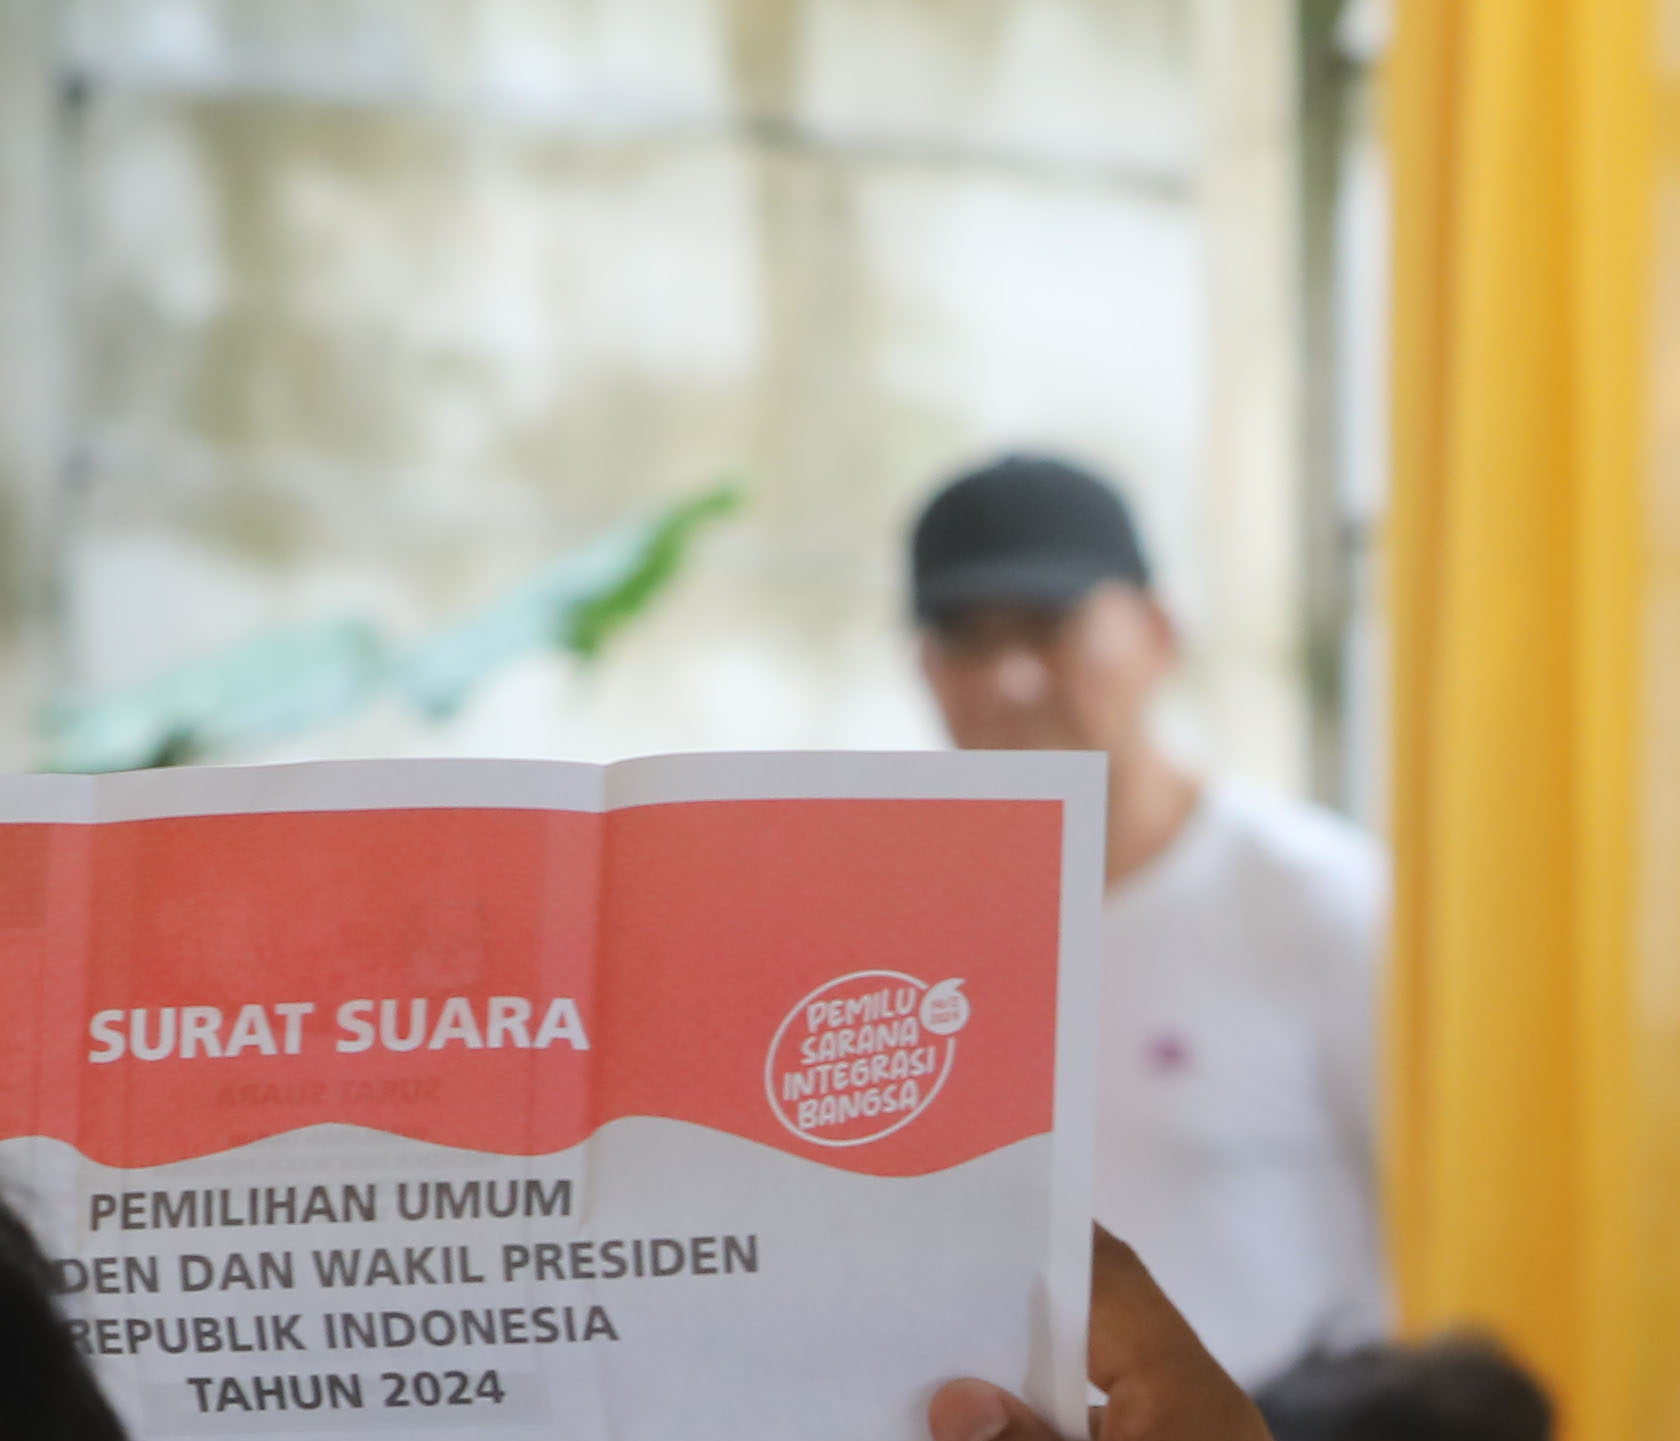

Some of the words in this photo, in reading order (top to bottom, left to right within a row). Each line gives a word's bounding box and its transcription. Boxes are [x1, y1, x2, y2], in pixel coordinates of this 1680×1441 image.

[88, 1003, 314, 1063] SURAT
[335, 997, 590, 1052] SUARA
[807, 987, 916, 1032] PEMILU
[801, 1016, 919, 1065] SARANA
[783, 1046, 936, 1101] INTEGRASI
[798, 1079, 919, 1130] BANGSA
[90, 1183, 376, 1231] PEMILIHAN
[396, 1179, 573, 1220] UMUM
[61, 1256, 160, 1295] DEN
[180, 1251, 293, 1293] DAN
[312, 1244, 485, 1288] WAKIL
[503, 1234, 760, 1282] PRESIDEN
[68, 1313, 306, 1356] REPUBLIK
[326, 1304, 620, 1351] INDONESIA
[188, 1372, 363, 1413] TAHUN
[379, 1368, 506, 1408] 2024
